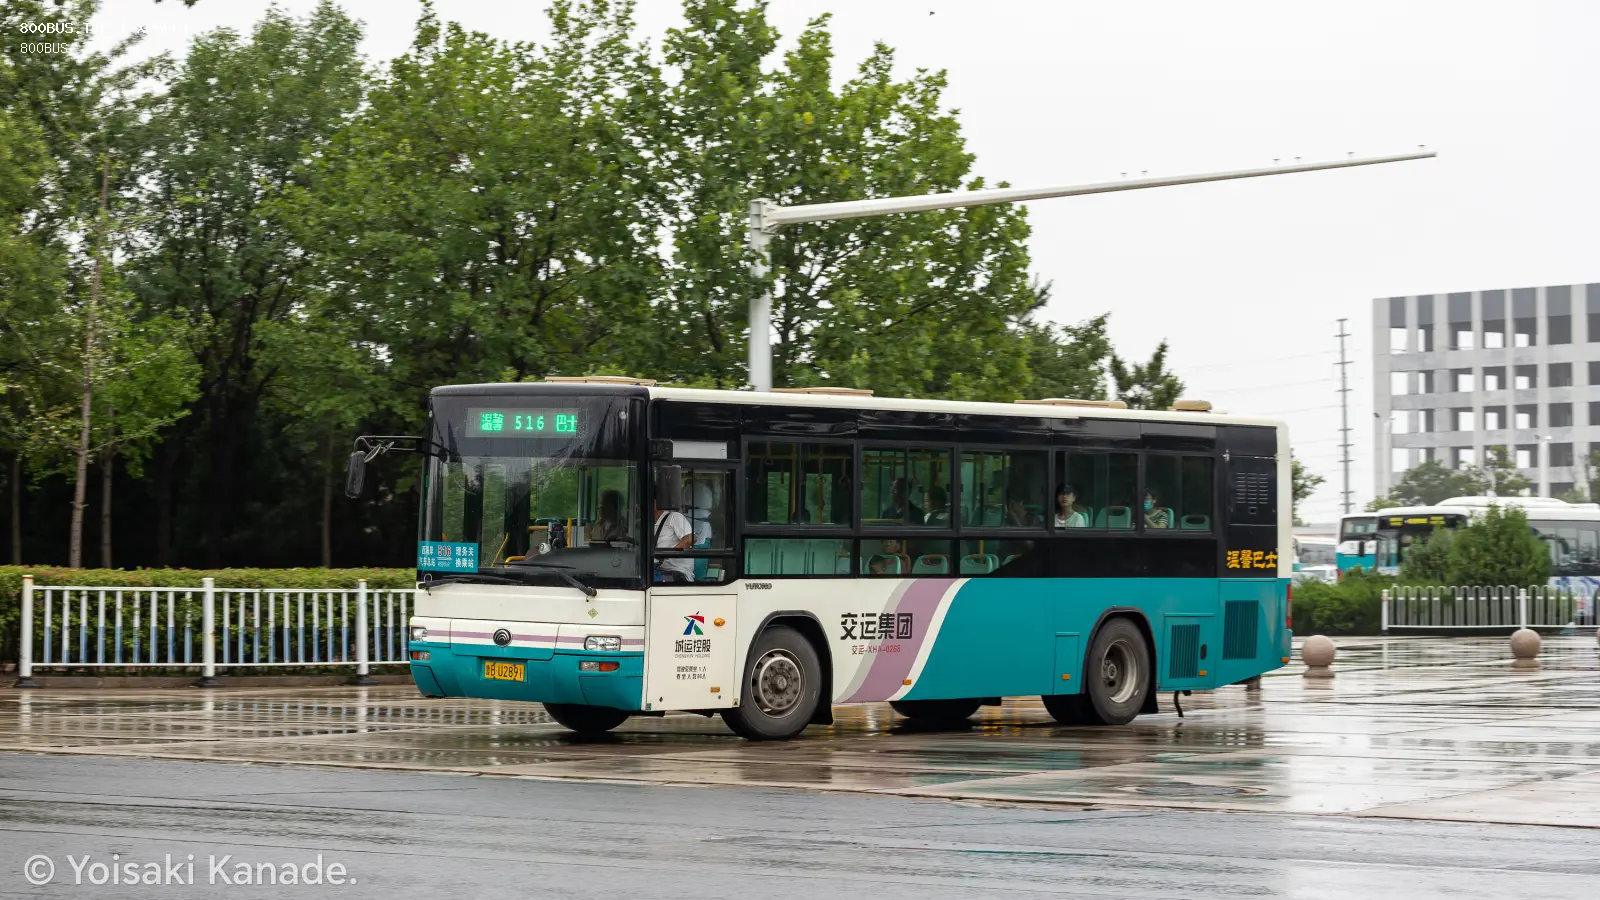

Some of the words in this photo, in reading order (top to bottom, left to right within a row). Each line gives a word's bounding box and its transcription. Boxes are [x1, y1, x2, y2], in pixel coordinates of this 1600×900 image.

[515, 415, 545, 431] 516
[556, 414, 577, 433] 巴士
[840, 612, 913, 640] 交运集团
[674, 639, 711, 653] 城运控股
